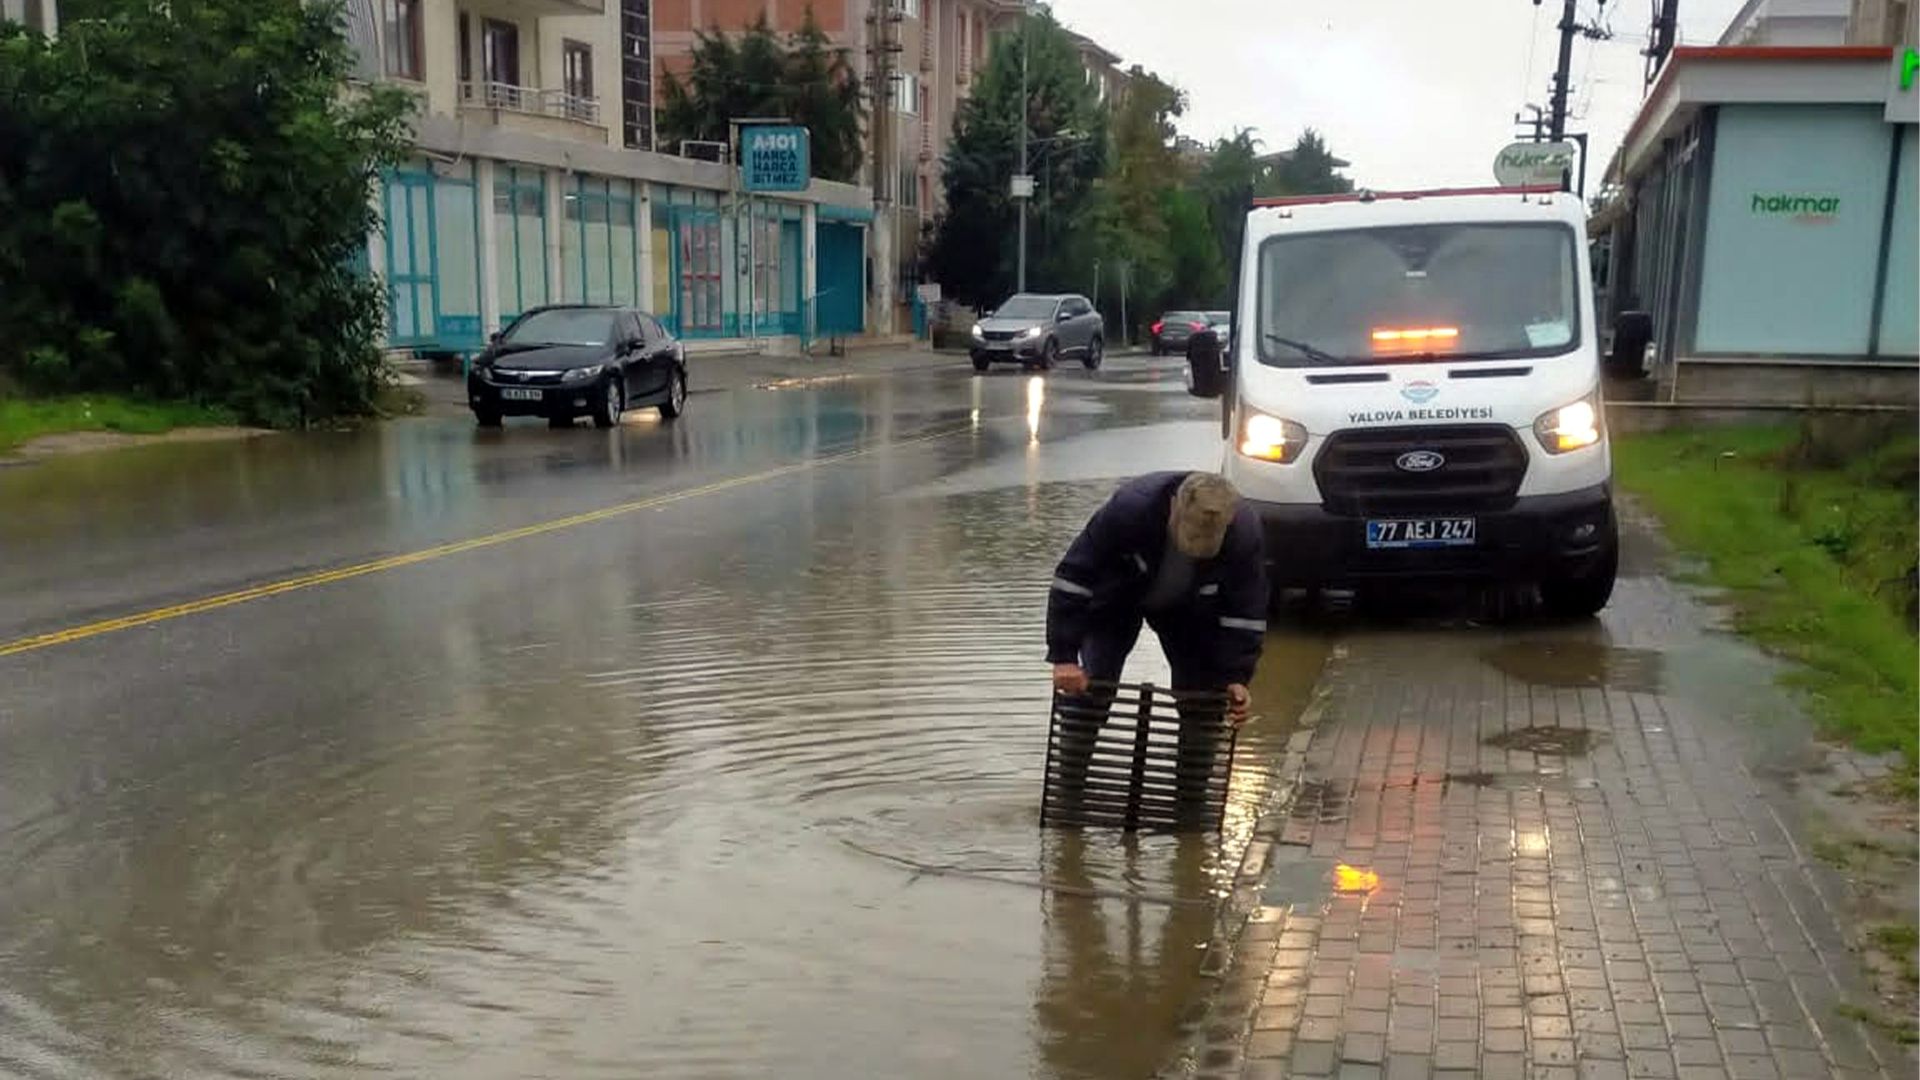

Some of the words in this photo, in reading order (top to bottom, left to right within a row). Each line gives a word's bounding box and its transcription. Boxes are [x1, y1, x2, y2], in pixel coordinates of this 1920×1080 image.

[752, 162, 797, 172] HARCA
[1752, 194, 1840, 212] hakmar
[1348, 411, 1403, 422] YALOVA
[1408, 406, 1493, 420] BELEDİYESİ
[1378, 523, 1397, 541] 77
[1405, 522, 1435, 540] AEJ
[1441, 521, 1472, 539] 247
